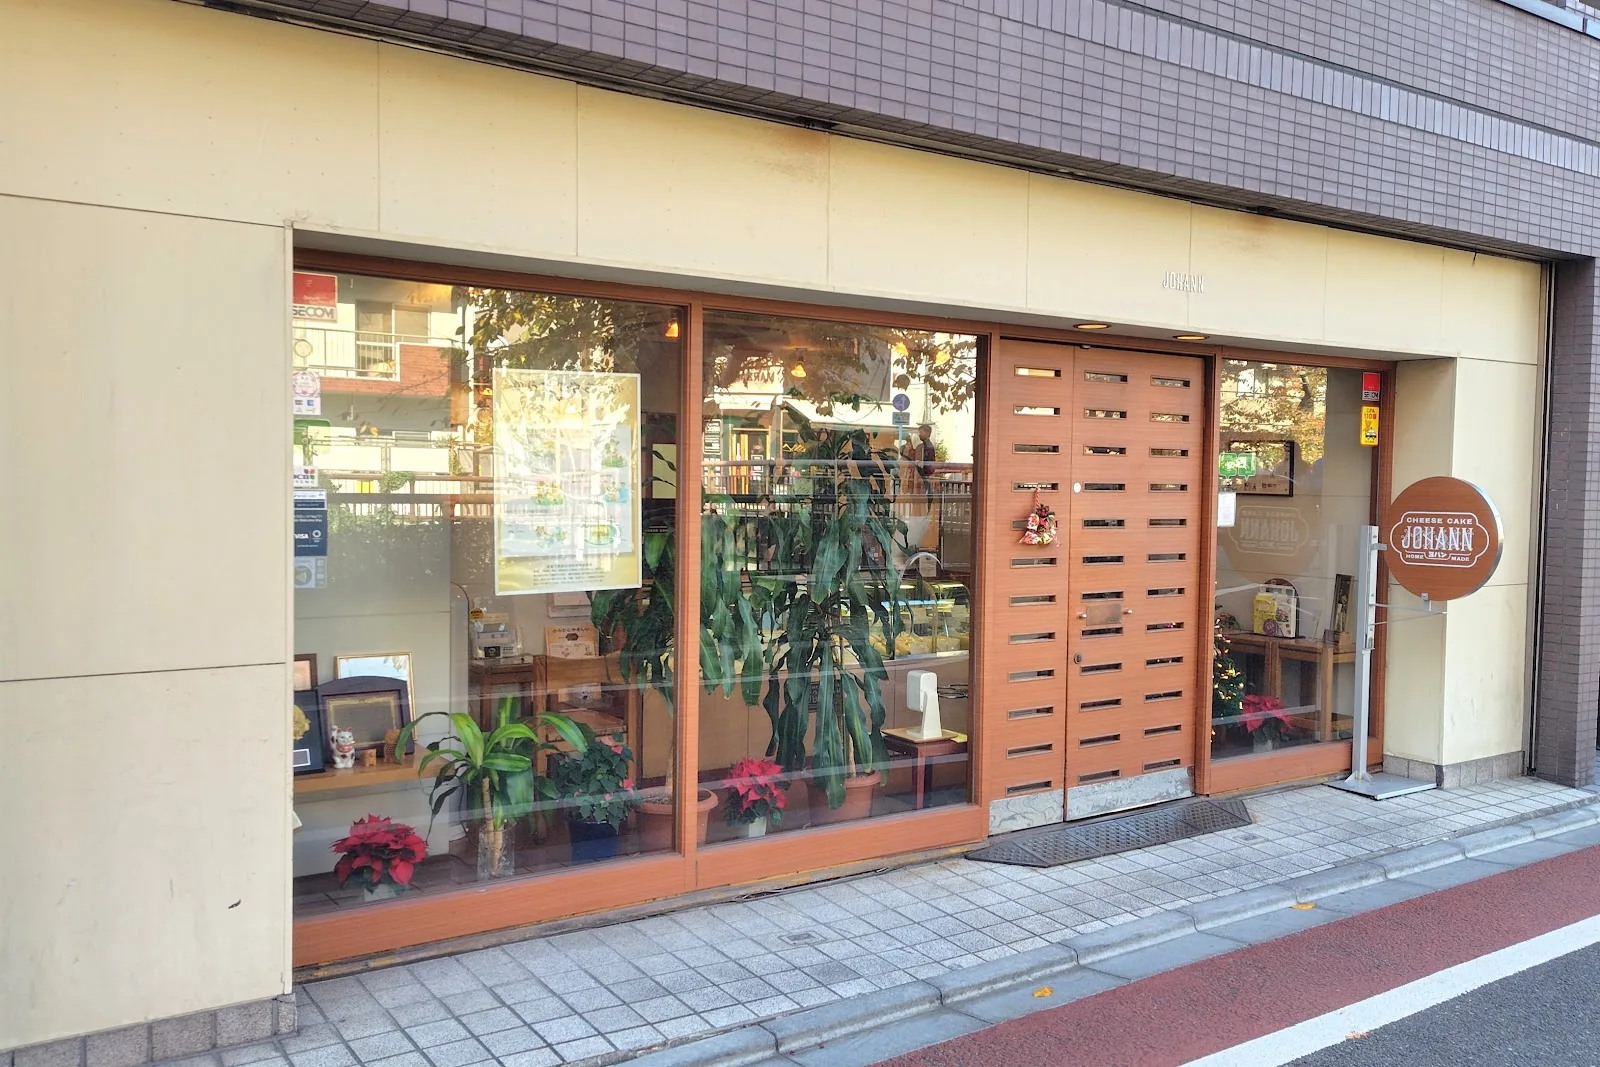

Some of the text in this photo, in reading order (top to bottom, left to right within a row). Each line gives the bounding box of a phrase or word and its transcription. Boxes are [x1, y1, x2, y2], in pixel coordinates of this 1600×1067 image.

[1162, 271, 1204, 293] JOHANN
[293, 305, 334, 319] SECOM
[1401, 526, 1474, 552] JOHANN
